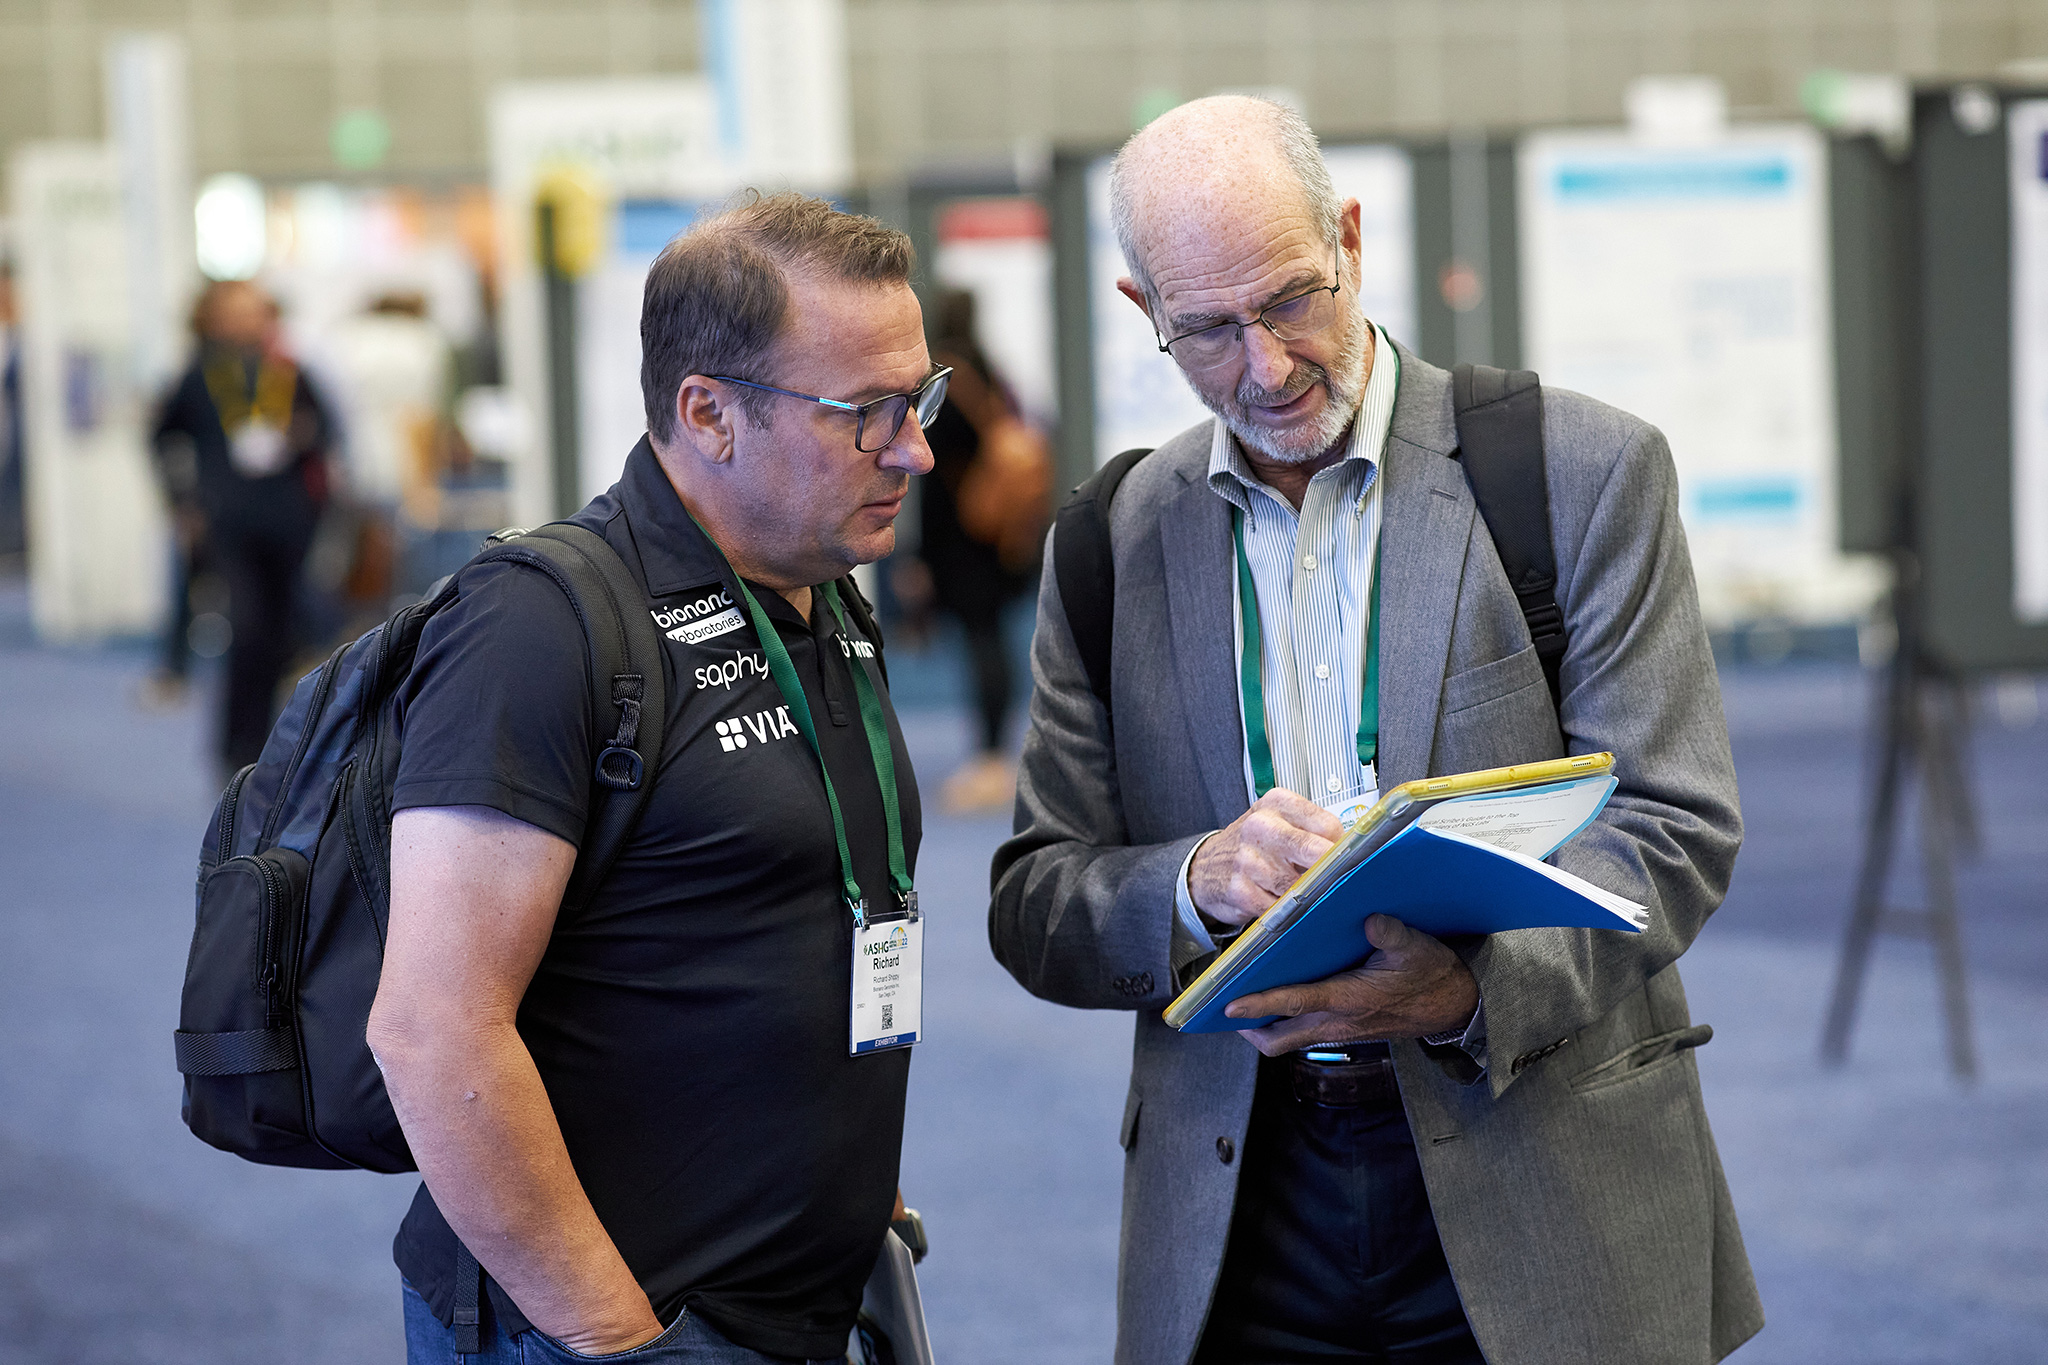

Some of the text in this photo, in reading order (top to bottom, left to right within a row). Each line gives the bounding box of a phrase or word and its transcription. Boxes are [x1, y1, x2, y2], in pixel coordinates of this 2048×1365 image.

[672, 614, 741, 643] laboratories
[694, 650, 771, 691] saphy
[742, 704, 799, 744] VIA
[867, 941, 889, 956] ASHG
[873, 954, 900, 970] Richard
[874, 1036, 898, 1047] EXHIBITOR
